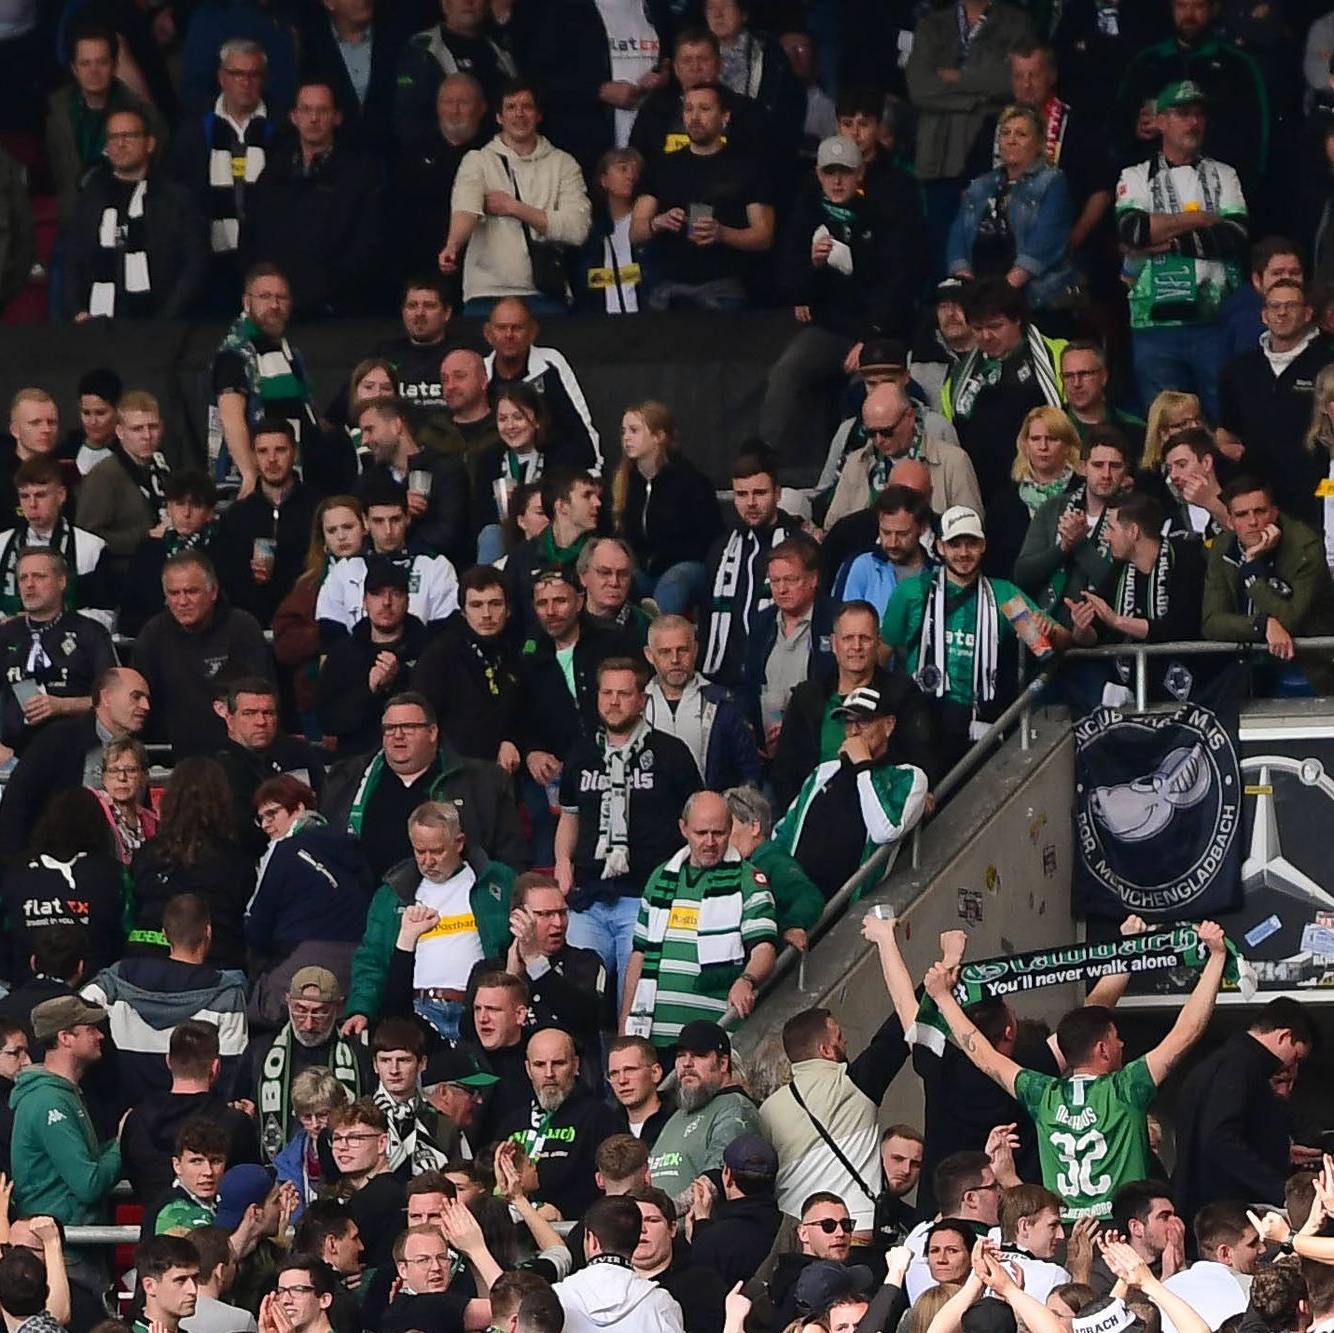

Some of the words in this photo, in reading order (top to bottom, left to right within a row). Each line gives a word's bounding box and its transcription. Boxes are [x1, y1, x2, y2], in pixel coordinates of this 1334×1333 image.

[986, 976, 1033, 997] You'll
[1035, 966, 1085, 988] never
[1086, 959, 1128, 978] walk
[1131, 953, 1177, 970] alone
[1049, 1128, 1111, 1197] 32
